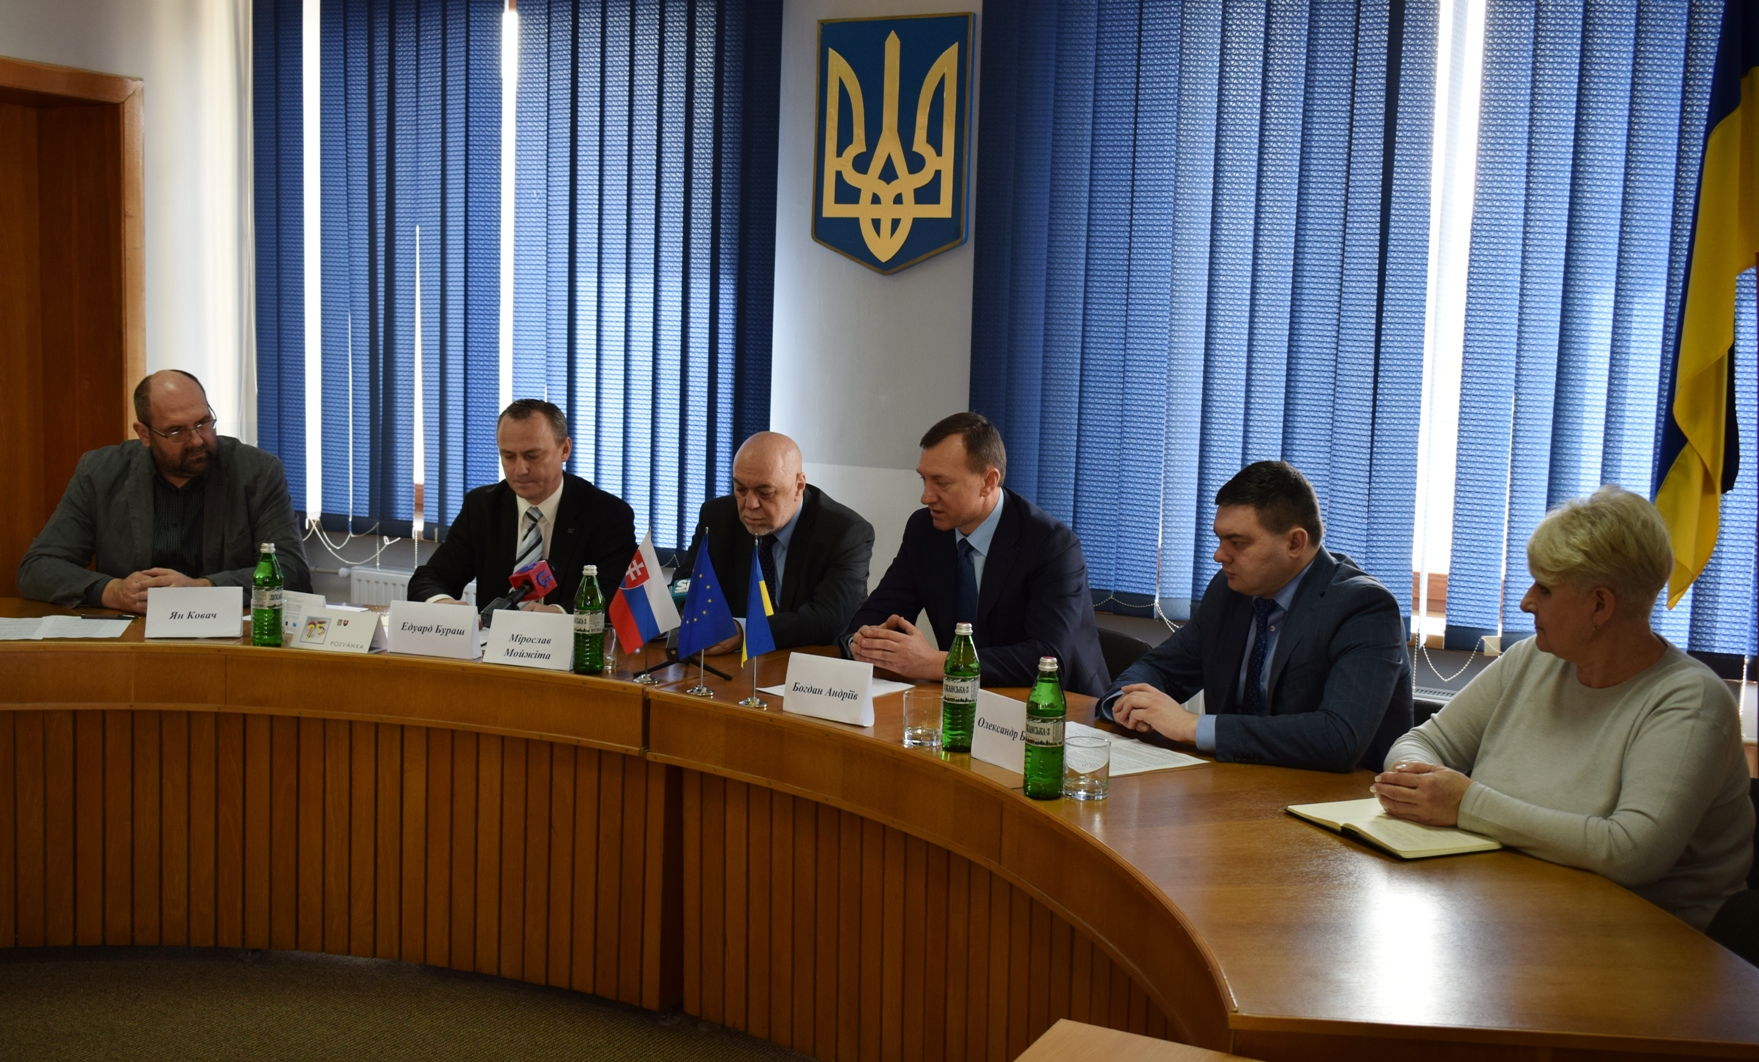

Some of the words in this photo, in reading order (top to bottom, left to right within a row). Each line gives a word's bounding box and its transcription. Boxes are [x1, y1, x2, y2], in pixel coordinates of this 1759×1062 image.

[169, 611, 184, 620] Ян
[186, 611, 217, 620] Ковач
[401, 621, 433, 634] Едуард
[434, 624, 466, 637] Бураш
[329, 640, 364, 650] POZVÁNKA
[508, 633, 552, 645] Мірослав
[503, 648, 552, 660] Мойжіта
[792, 681, 823, 695] Богдан
[824, 687, 859, 701] Андріїв
[977, 716, 1019, 741] Олександр
